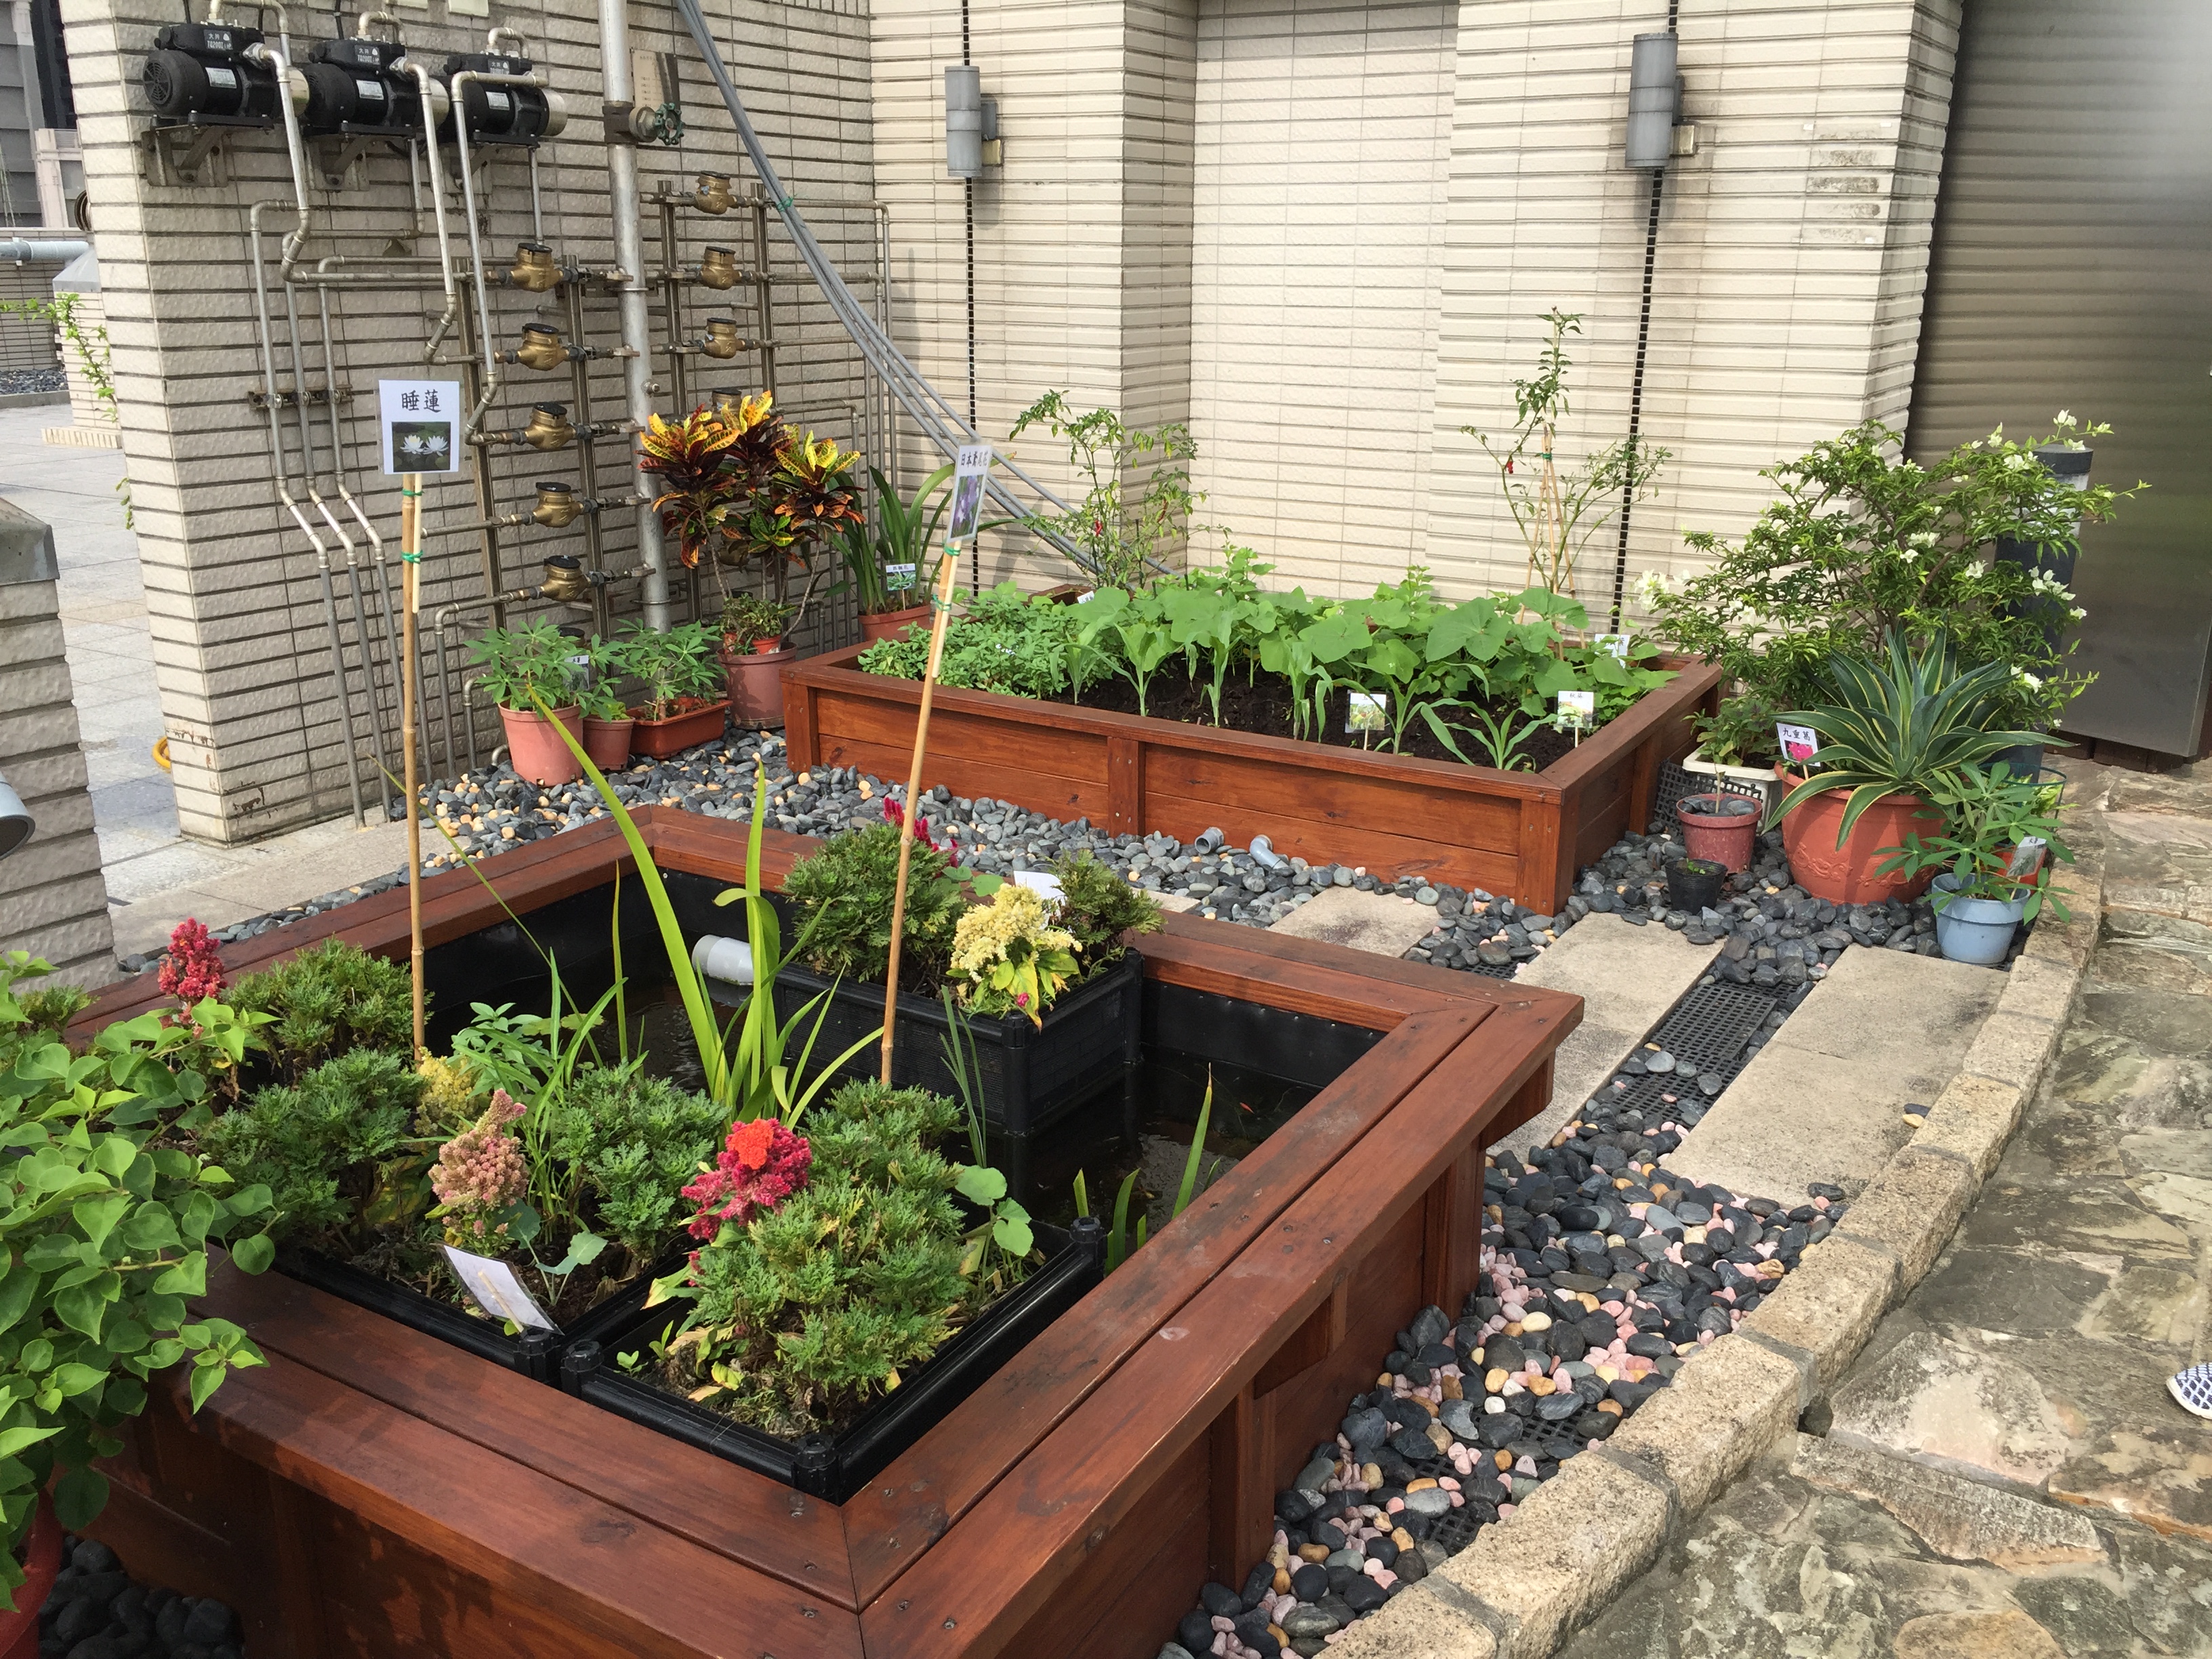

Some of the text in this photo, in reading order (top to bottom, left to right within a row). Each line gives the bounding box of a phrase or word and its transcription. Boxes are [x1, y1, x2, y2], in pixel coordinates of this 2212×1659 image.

[401, 389, 441, 413] 睡蓮
[1782, 727, 1811, 741] 九重葛
